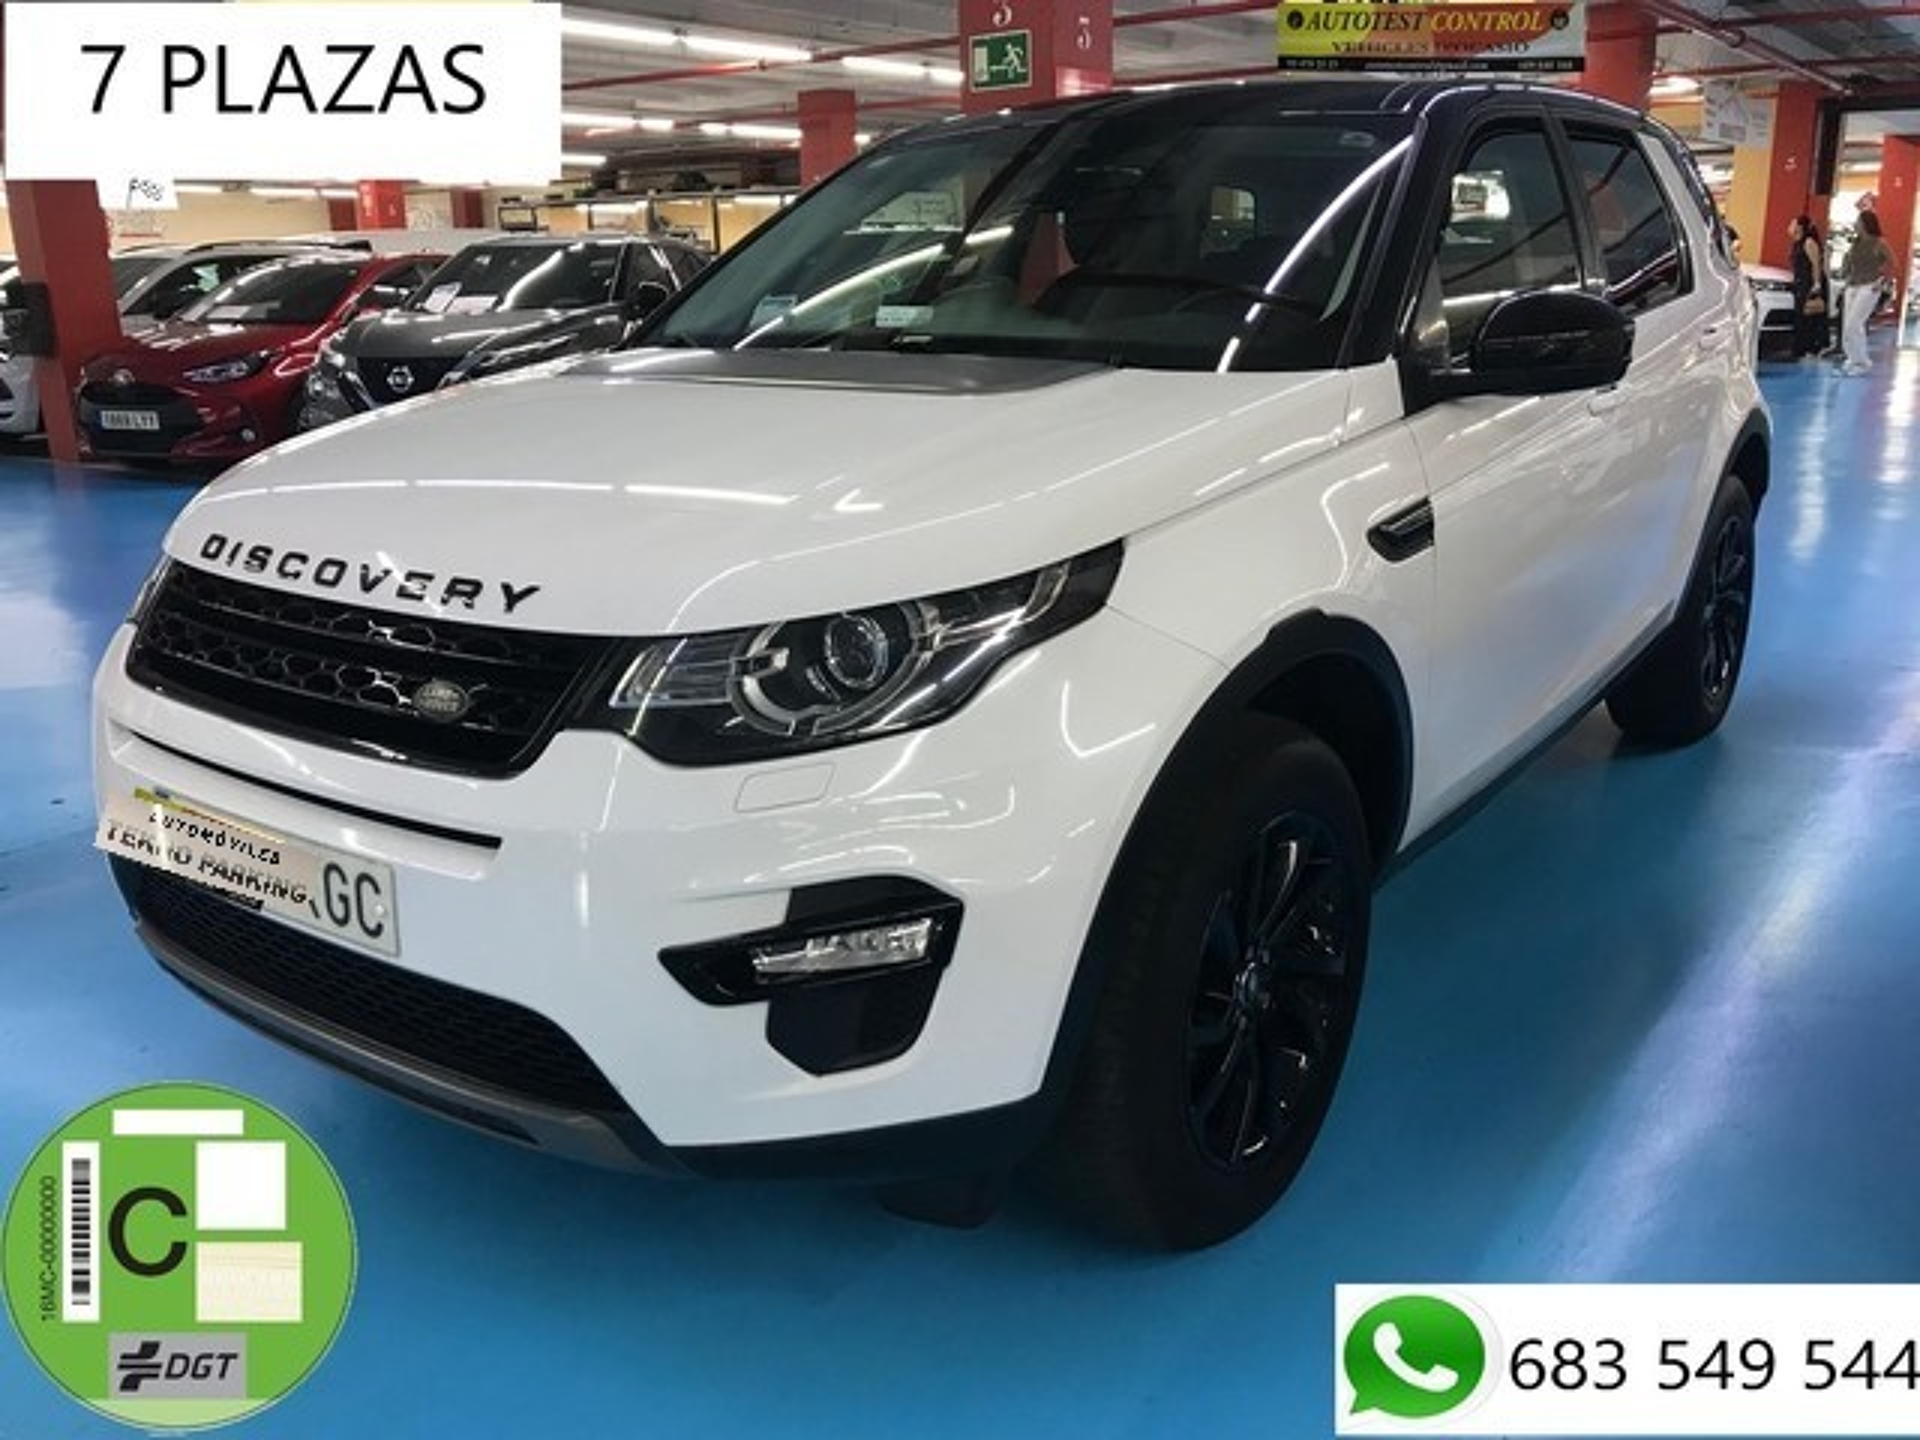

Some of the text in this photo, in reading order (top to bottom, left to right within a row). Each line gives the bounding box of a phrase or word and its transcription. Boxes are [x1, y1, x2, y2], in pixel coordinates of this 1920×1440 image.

[1305, 11, 1544, 31] AUTOTEST CONTROL
[201, 533, 541, 613] DISCOVERY
[198, 852, 307, 904] PARKING
